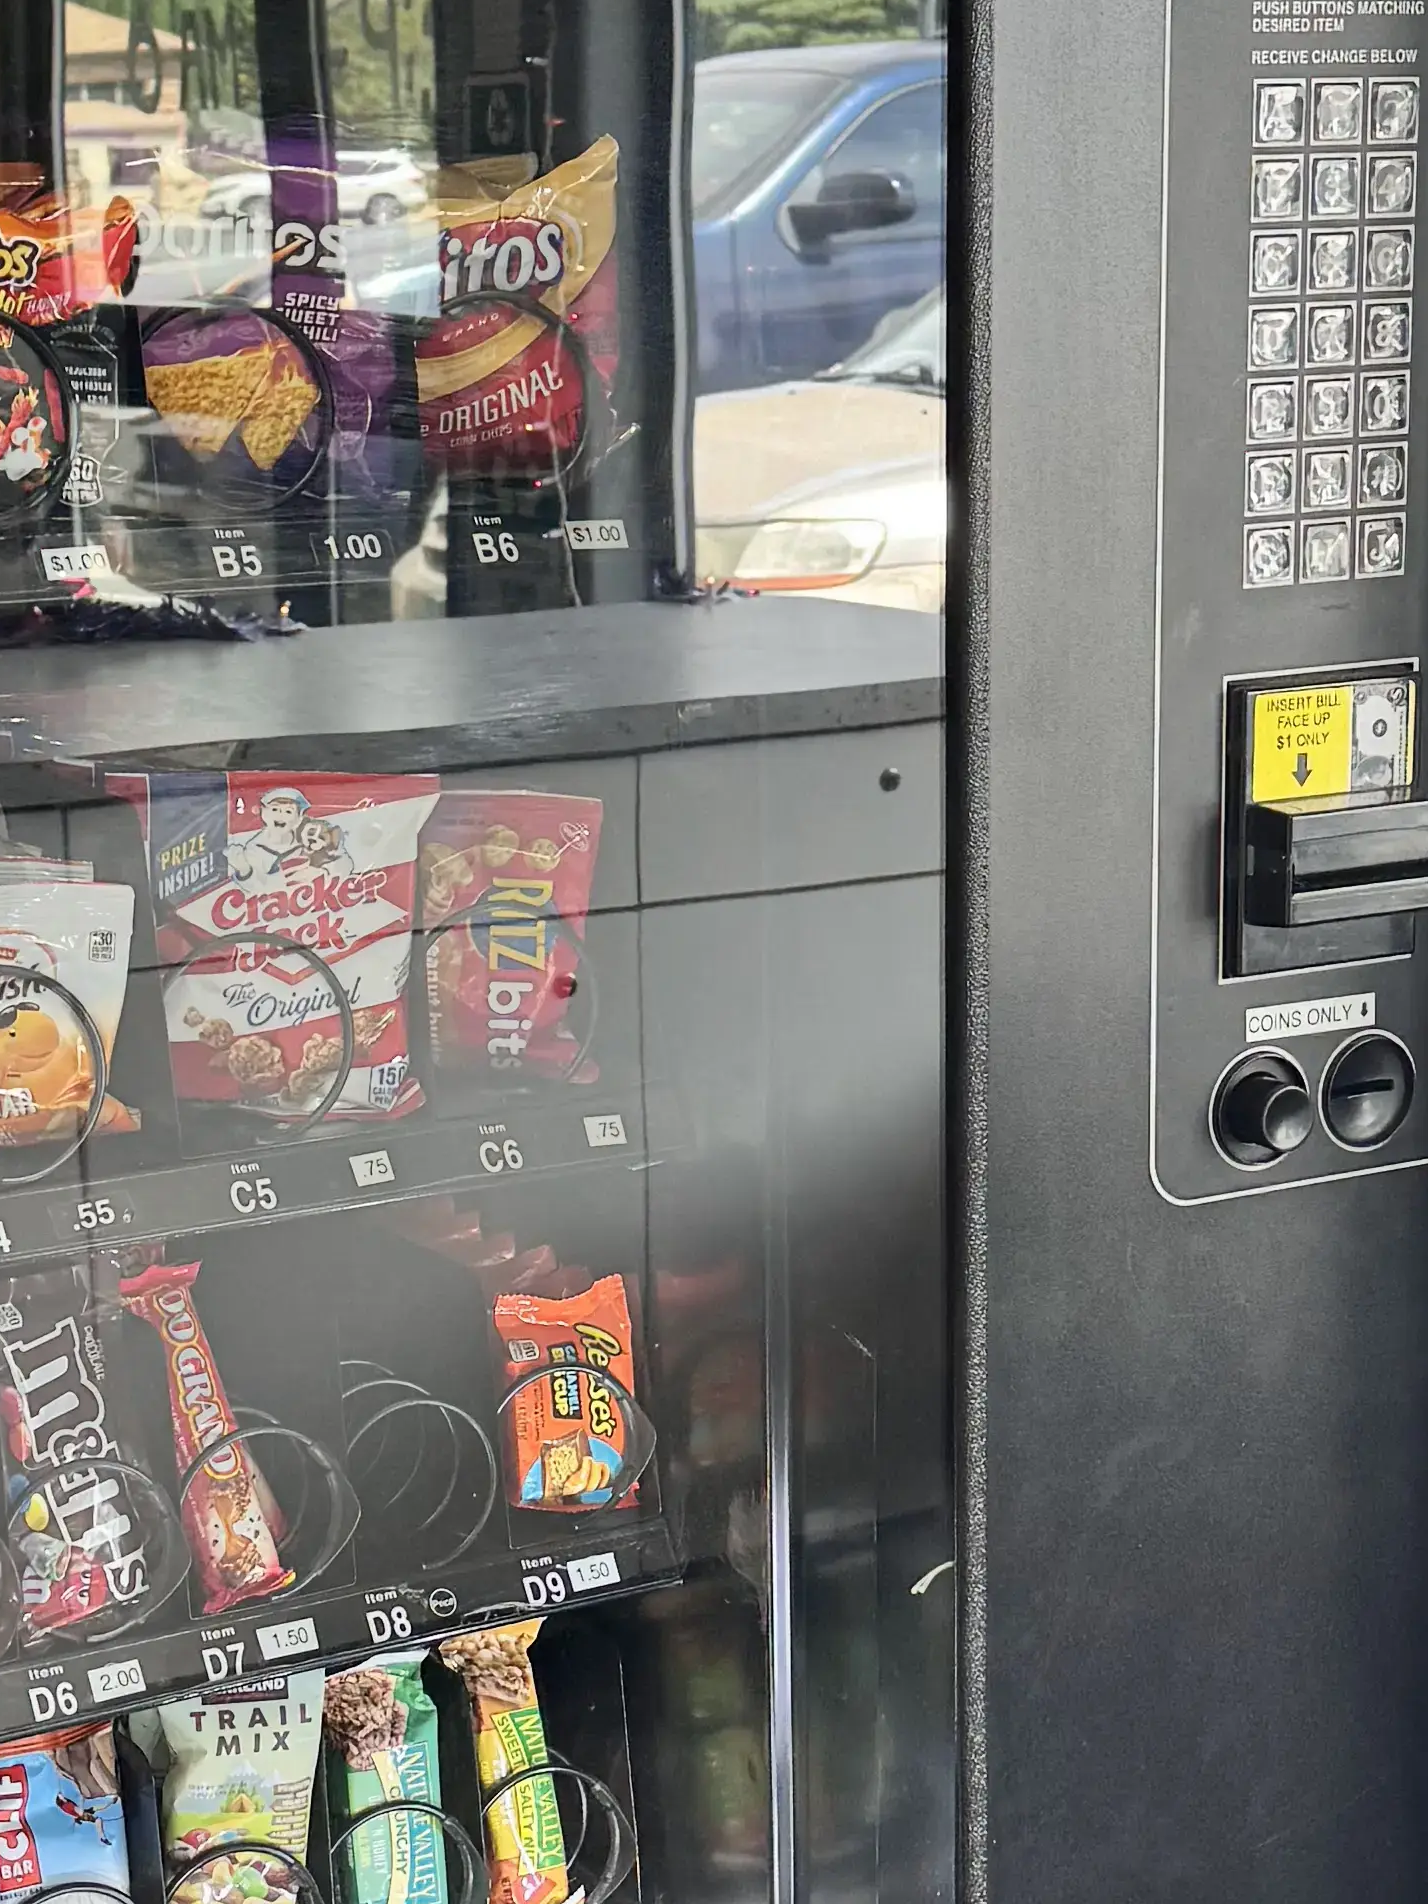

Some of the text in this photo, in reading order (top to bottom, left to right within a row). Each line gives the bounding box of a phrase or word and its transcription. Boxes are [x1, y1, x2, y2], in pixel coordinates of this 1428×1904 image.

[1252, 0, 1425, 16] PUSH BUTTONS MATCHING
[1252, 17, 1345, 33] DESIRED ITEM
[1251, 48, 1418, 65] RECEIVE CHANGE BELOW
[284, 292, 341, 311] SPICY
[438, 360, 565, 436] ORIGINAL
[324, 533, 382, 560] 1.00
[472, 531, 520, 564] B6
[573, 524, 621, 544] $1.00
[51, 553, 107, 573] $1.00
[212, 544, 263, 579] B5
[1265, 691, 1342, 713] INSERT BILL
[1276, 709, 1331, 730] FACE UP
[1276, 728, 1331, 750] $1 ONLY
[160, 832, 207, 872] PRIZE
[158, 854, 215, 900] INSIDE!
[210, 870, 388, 930] Cracker
[488, 877, 554, 972] RITZ
[222, 981, 258, 1008] The
[486, 980, 535, 1071] bits
[1247, 1002, 1353, 1037] COINS ONLY
[595, 1120, 621, 1139] .75
[362, 1157, 389, 1178] .75
[478, 1139, 525, 1173] C6
[229, 1178, 279, 1214] C5
[73, 1198, 116, 1230] .55
[575, 1561, 611, 1581] 1.50
[521, 1571, 567, 1608] D9
[271, 1626, 310, 1647] 1.50
[364, 1610, 413, 1644] D8
[201, 1642, 247, 1681] D7
[99, 1667, 140, 1691] 2.00
[28, 1681, 78, 1722] D6
[189, 1702, 312, 1732] TRAIL
[215, 1730, 291, 1757] MIX
[0, 1859, 35, 1879] BAR
[411, 1829, 437, 1904] VALLEY
